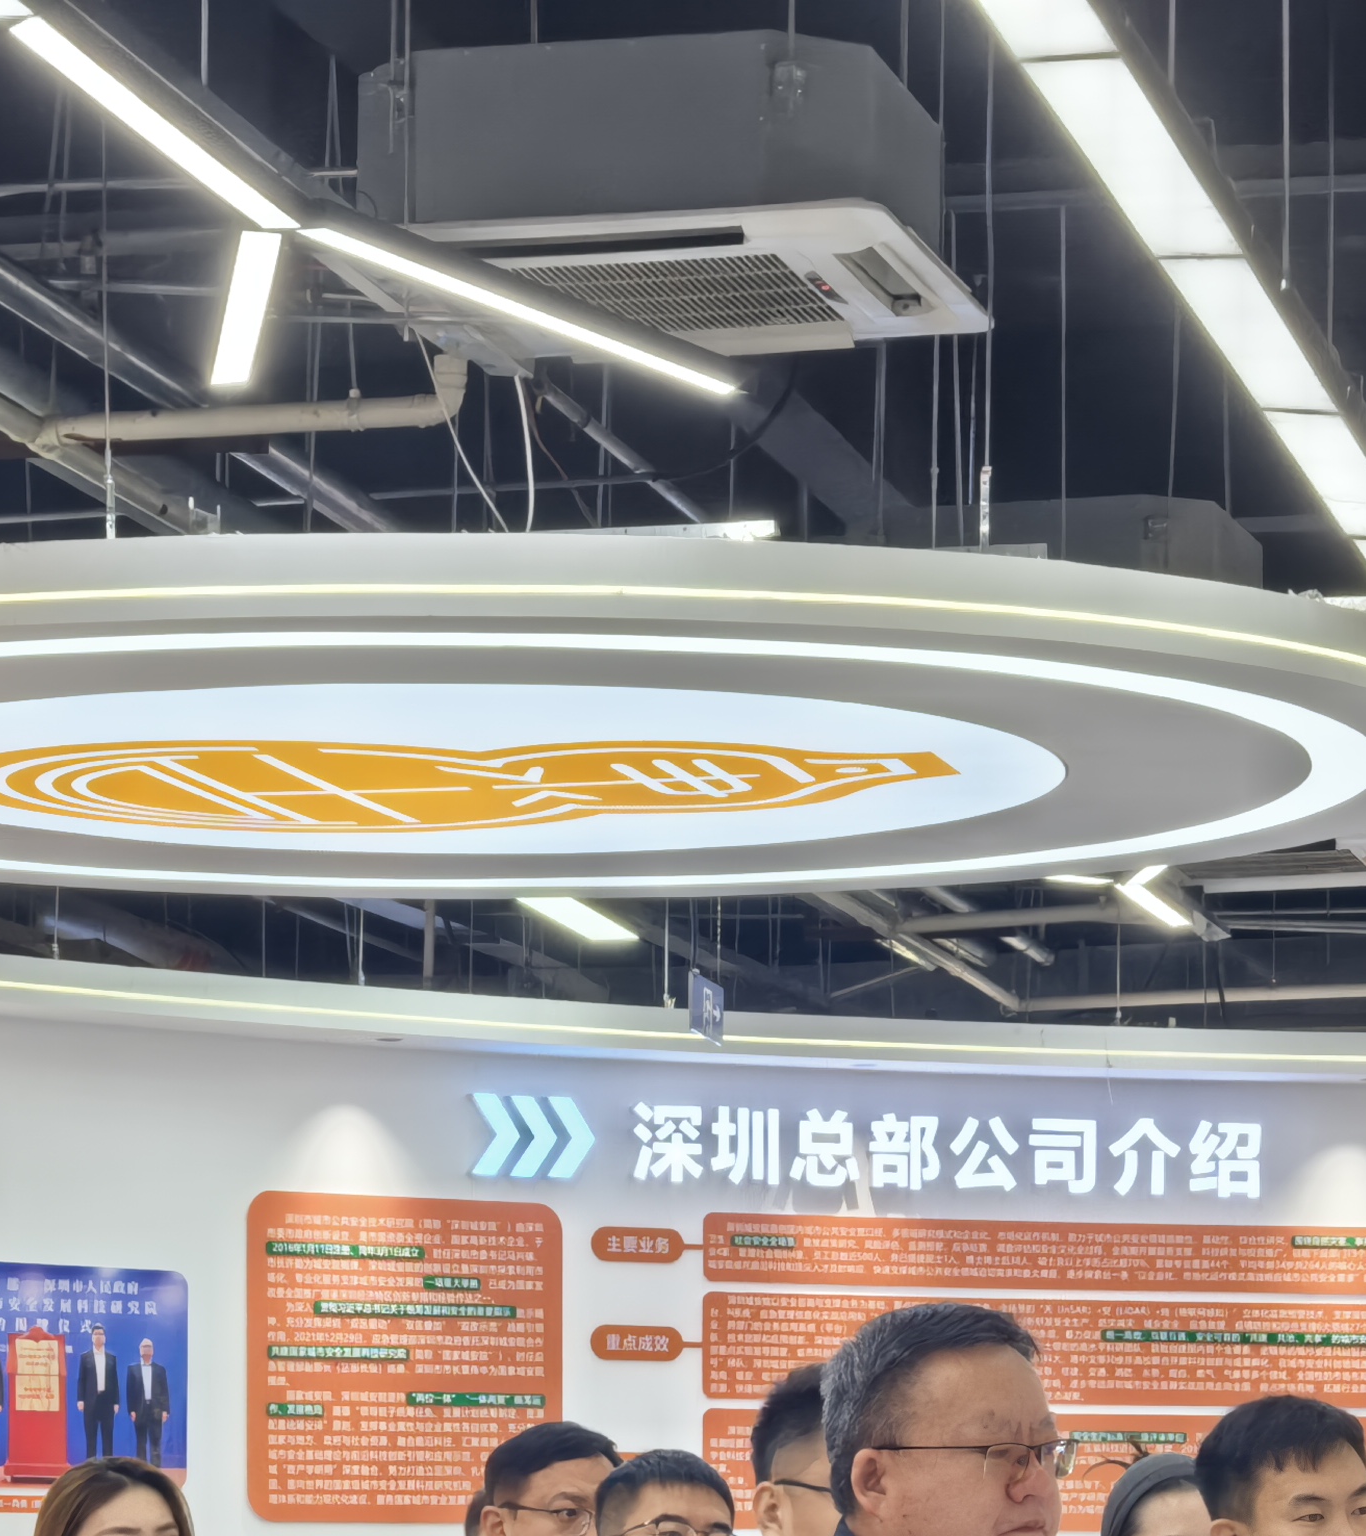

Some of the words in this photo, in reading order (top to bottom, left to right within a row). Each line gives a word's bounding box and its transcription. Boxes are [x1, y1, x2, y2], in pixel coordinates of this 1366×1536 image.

[633, 1099, 1263, 1200] 深圳总部公司介绍
[606, 1235, 670, 1254] 主要业务
[606, 1333, 669, 1353] 重点成效
